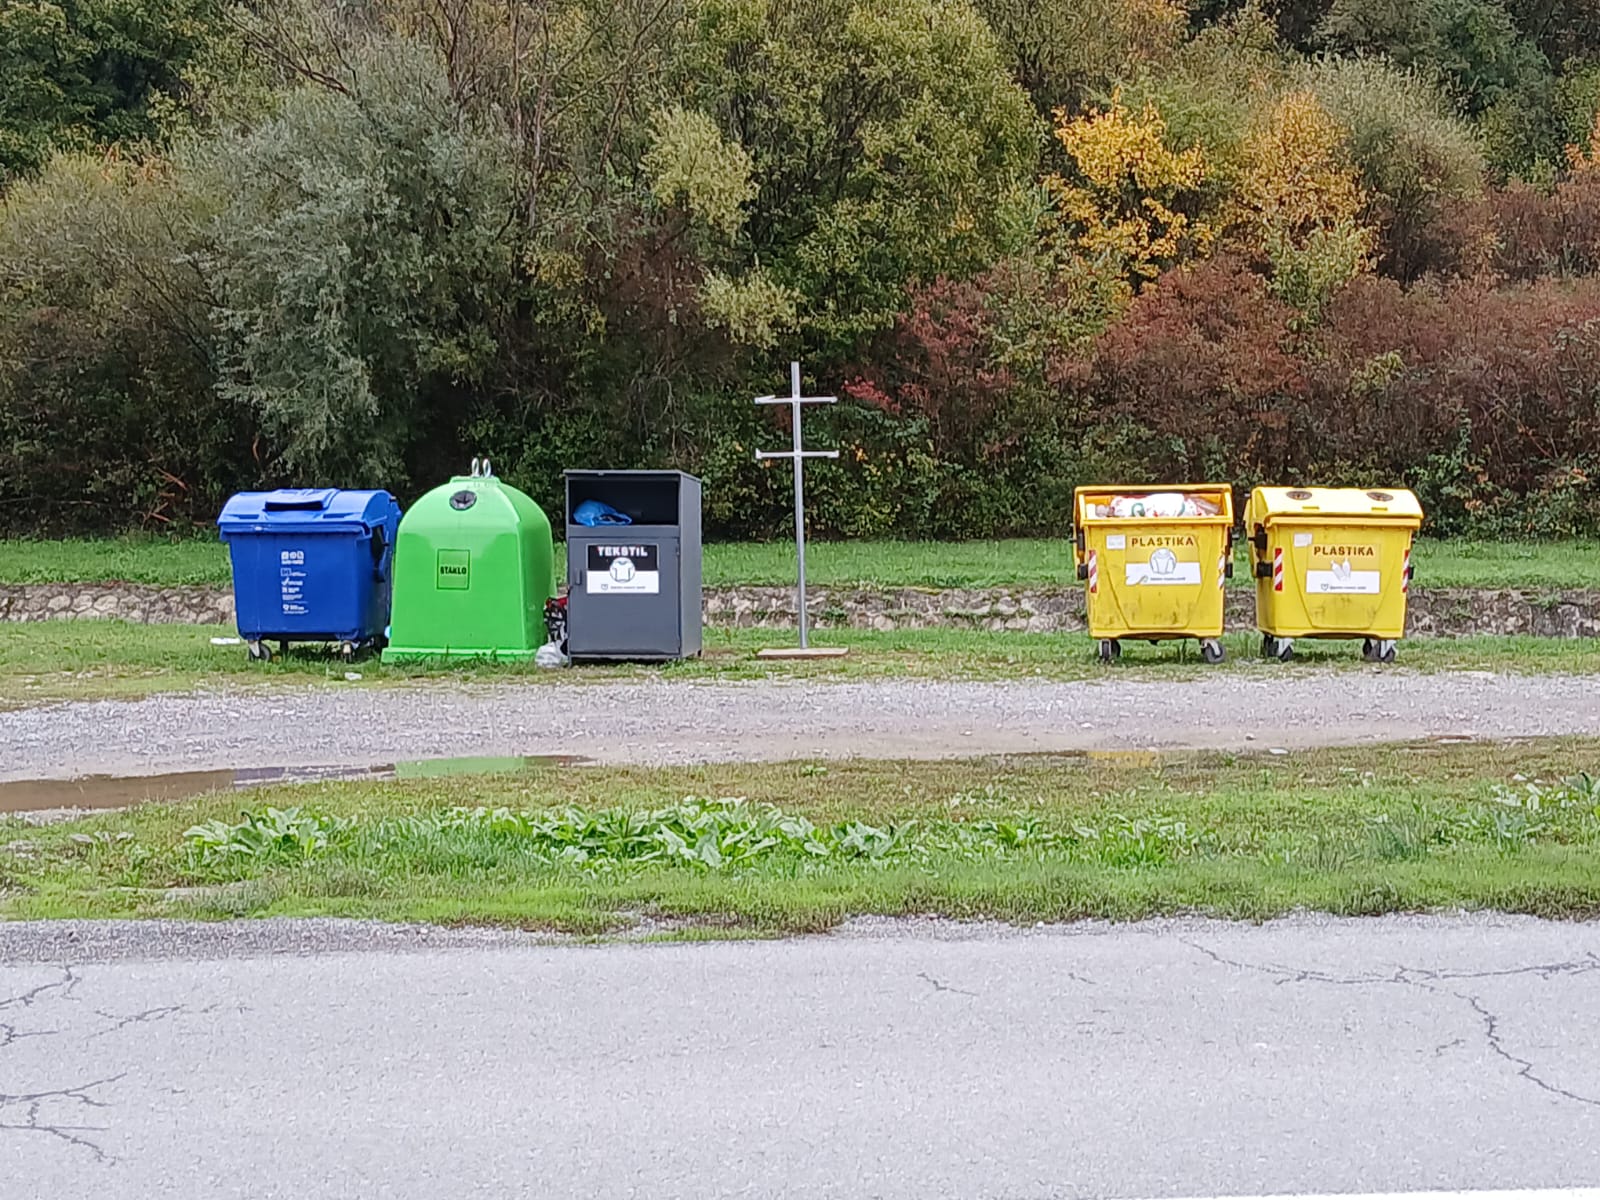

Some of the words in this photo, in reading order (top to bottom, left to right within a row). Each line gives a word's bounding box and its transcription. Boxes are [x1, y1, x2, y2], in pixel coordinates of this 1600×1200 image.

[1131, 537, 1194, 547] PLASTIKA
[597, 546, 648, 557] TEKSTIL
[1313, 546, 1374, 556] PLASTIKA
